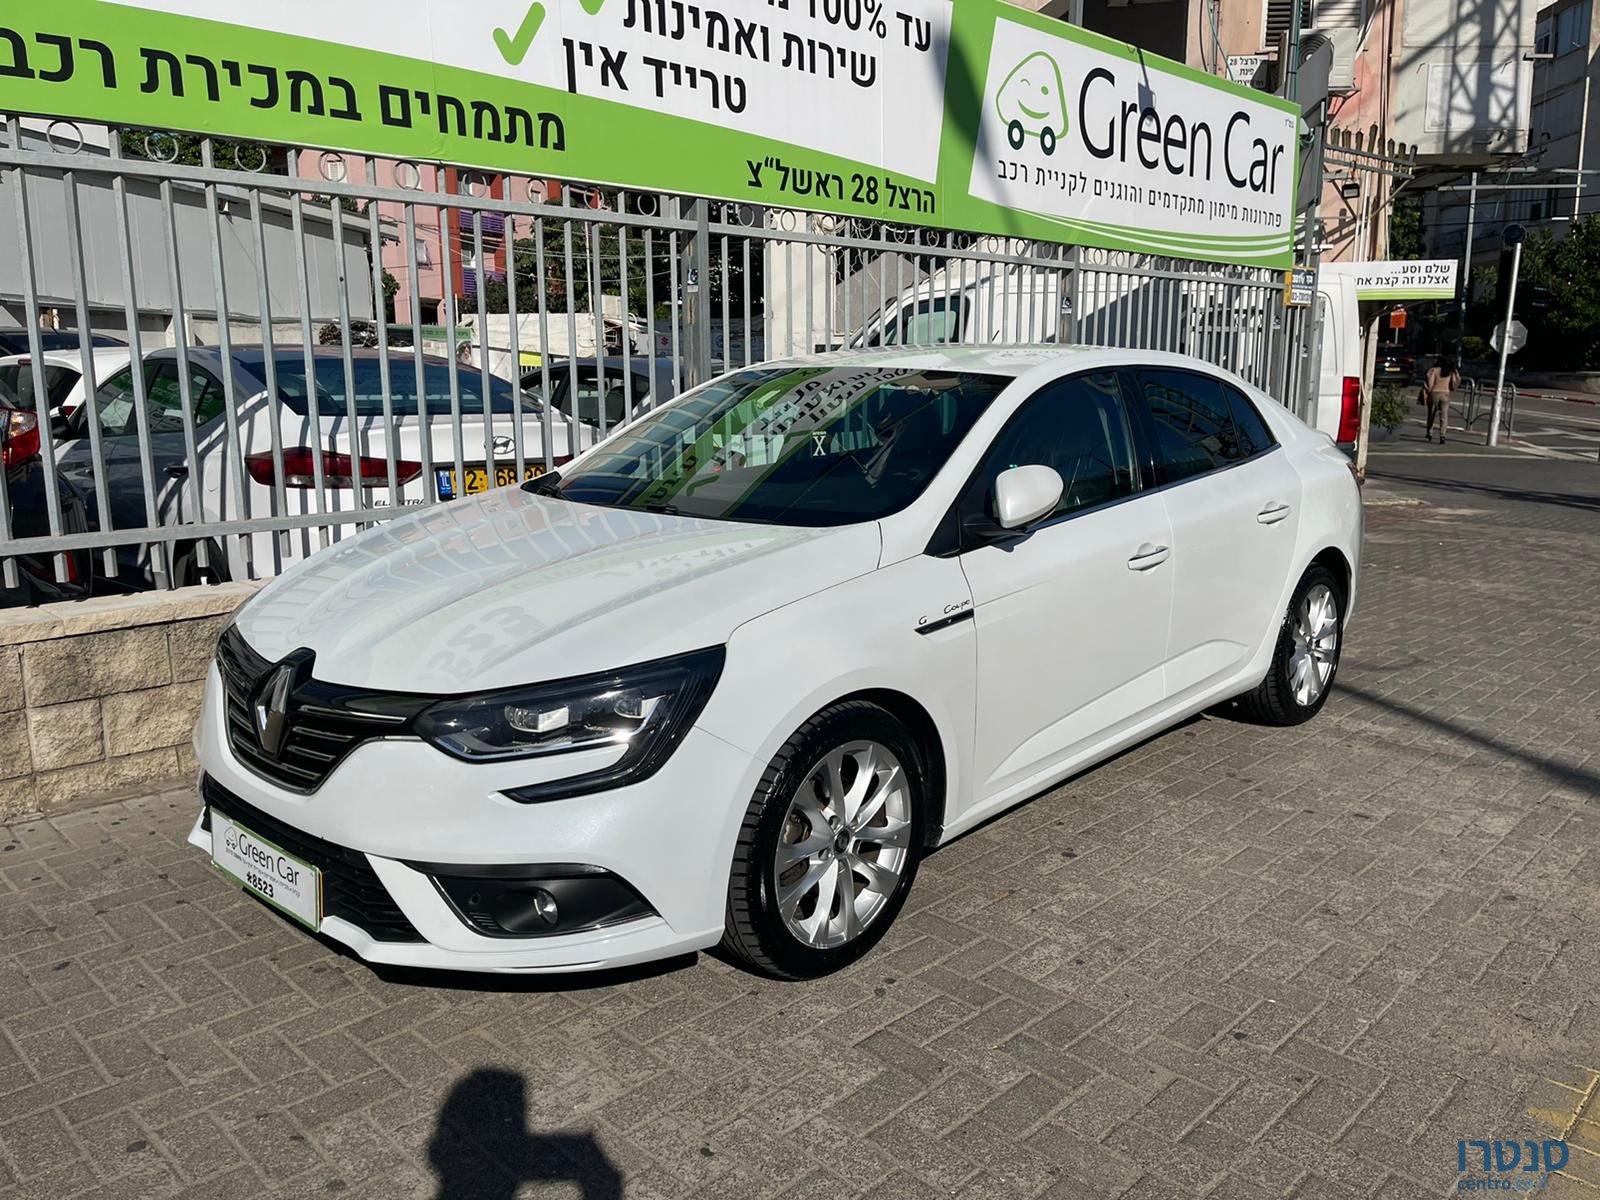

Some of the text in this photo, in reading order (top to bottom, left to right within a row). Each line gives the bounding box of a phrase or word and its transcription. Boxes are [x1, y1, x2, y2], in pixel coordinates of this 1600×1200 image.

[623, 0, 877, 88] שירות ואמינות
[896, 11, 932, 52] עד
[0, 27, 567, 152] מתמחים במכירת רכב
[562, 37, 747, 114] טרייד אין
[1078, 67, 1285, 195] Green Car
[851, 173, 879, 205] 28
[885, 177, 936, 214] הרצל
[997, 159, 1282, 228] פתרונות מימון מתקדמים והוגנים לקניית רכב
[1354, 274, 1450, 288] אצלנו זה קצת אח
[1425, 263, 1450, 274] שלם
[238, 833, 275, 873] Green
[277, 856, 300, 886] Car
